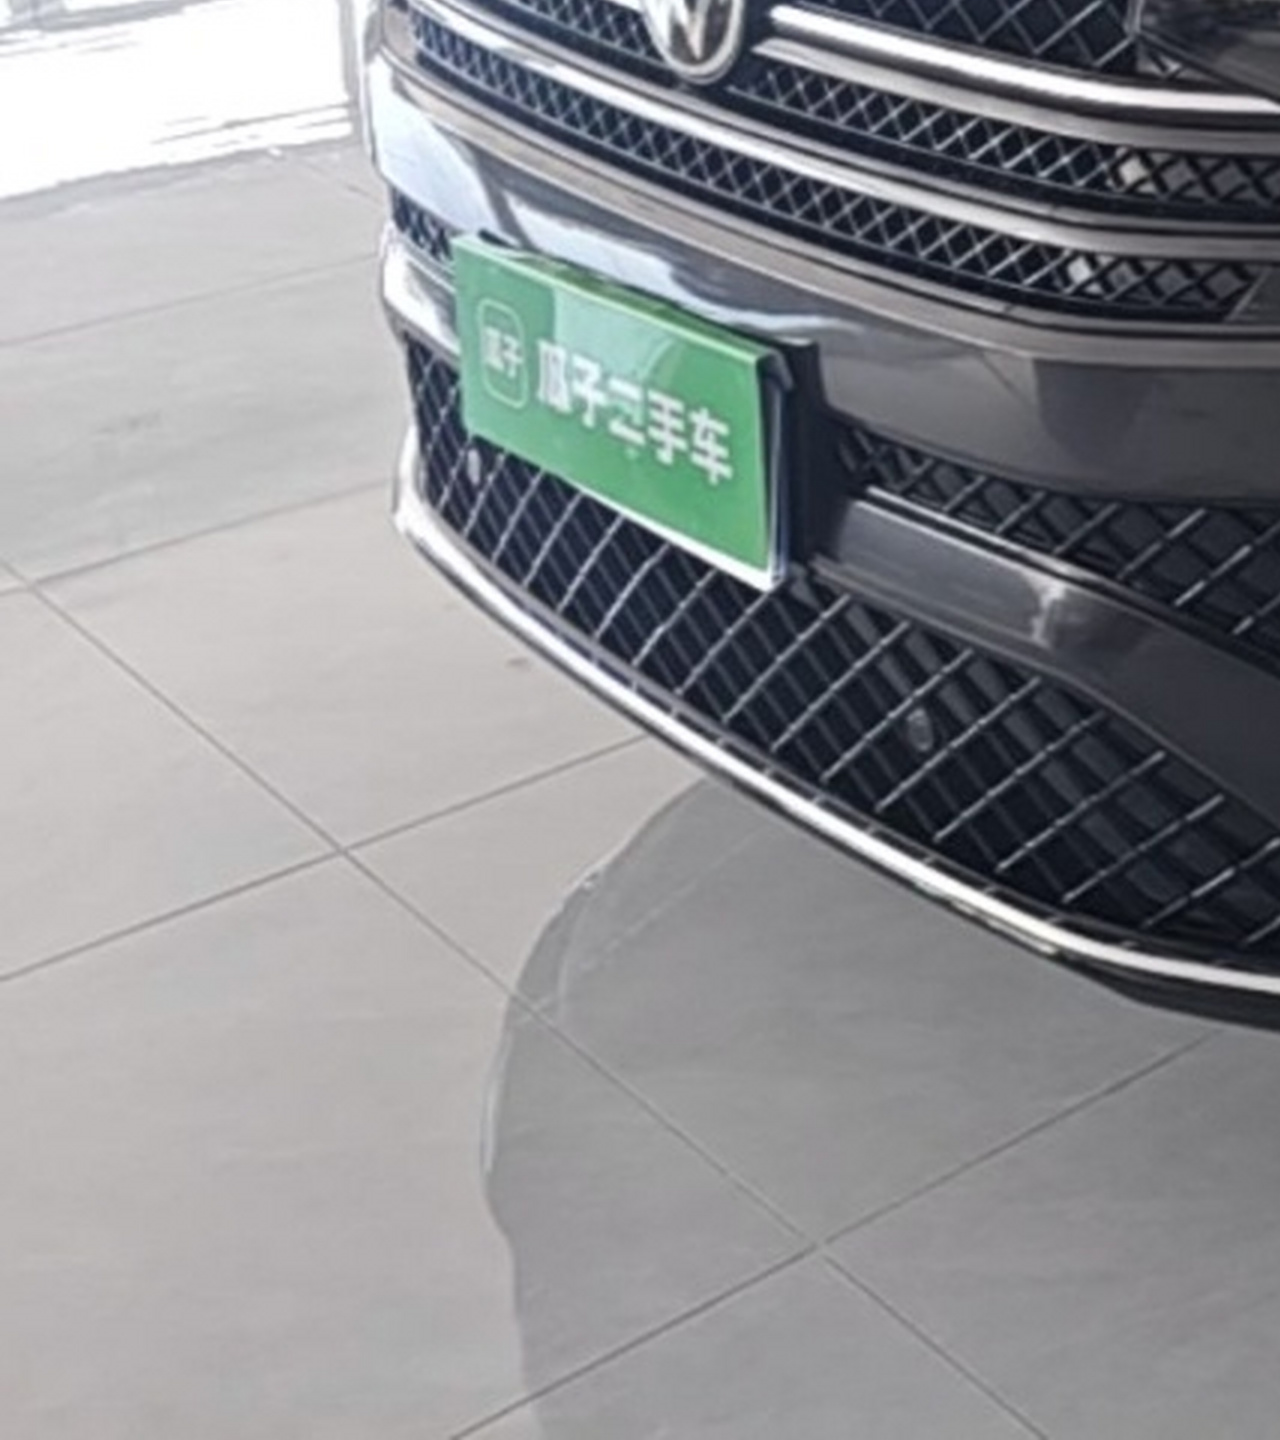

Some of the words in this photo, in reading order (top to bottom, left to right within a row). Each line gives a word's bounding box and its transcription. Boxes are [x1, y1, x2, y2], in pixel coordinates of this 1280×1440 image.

[535, 338, 735, 487] 瓜子二手车
